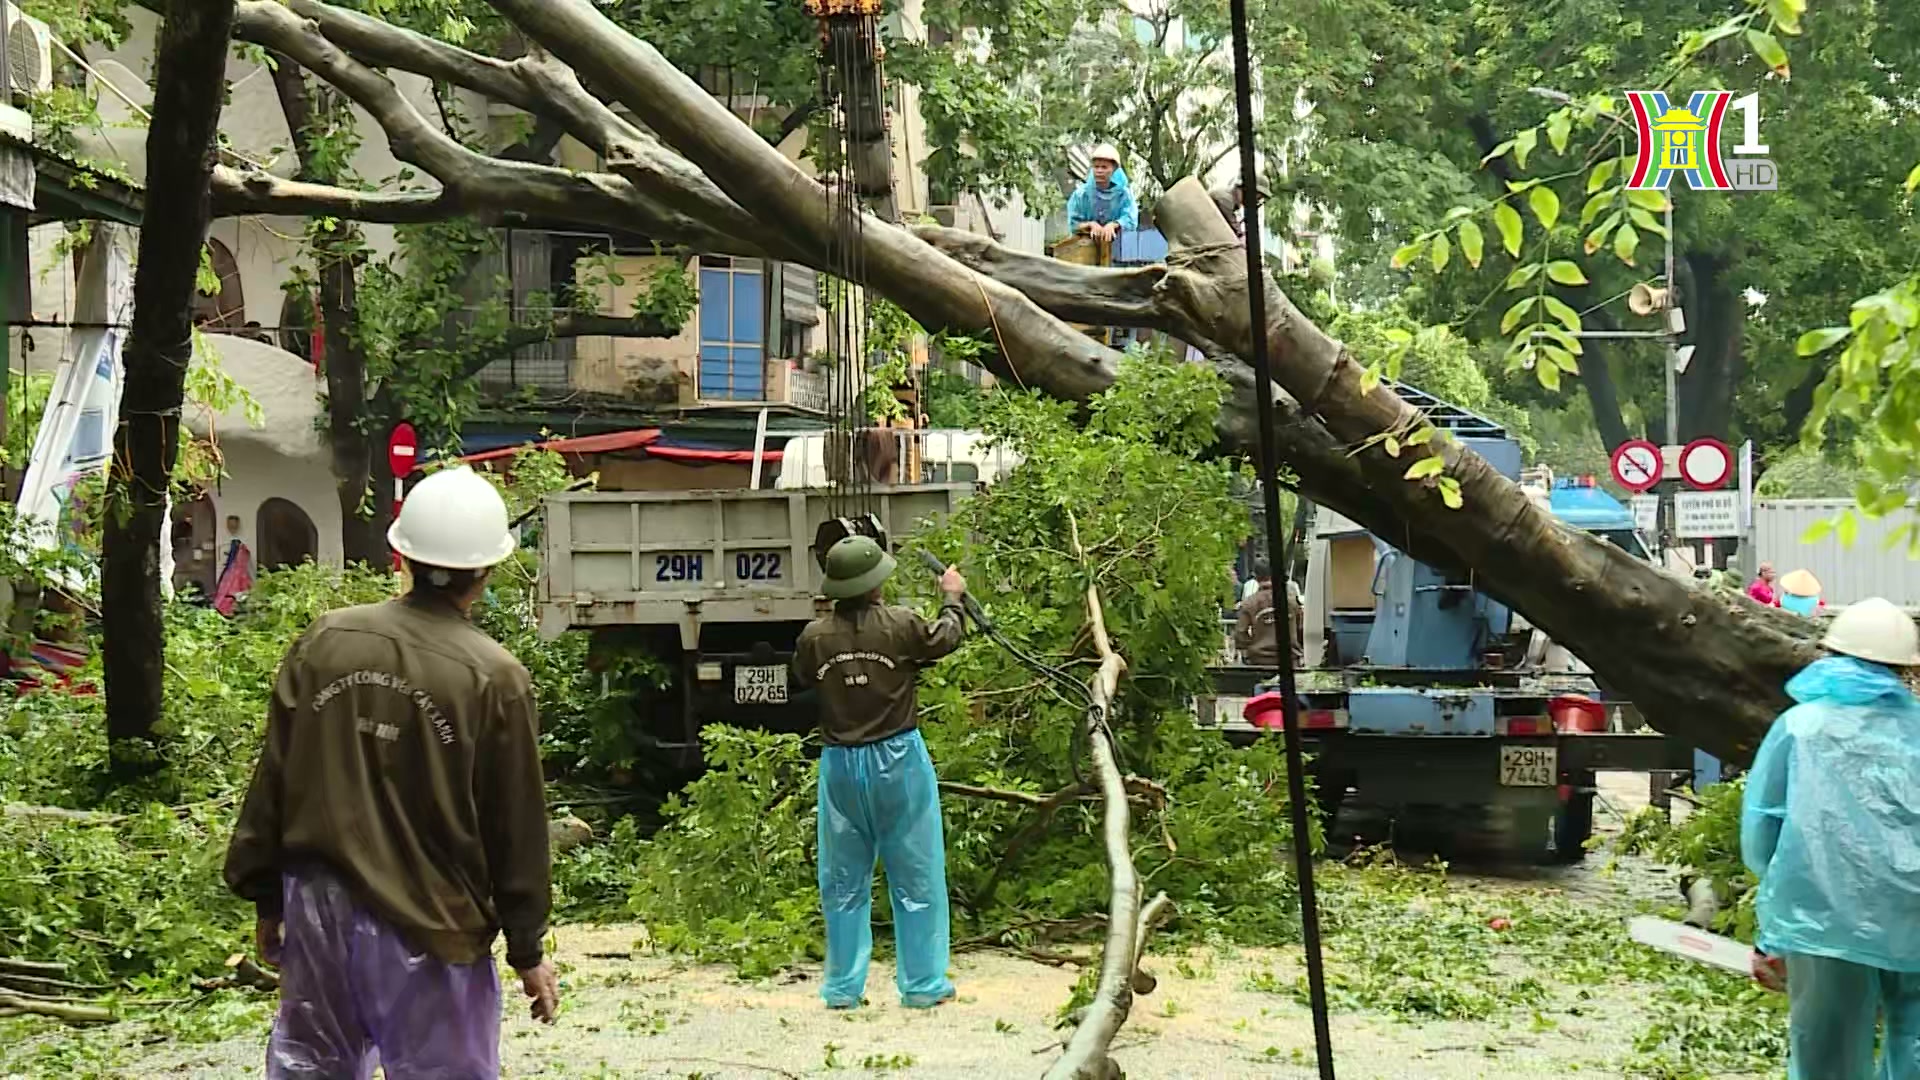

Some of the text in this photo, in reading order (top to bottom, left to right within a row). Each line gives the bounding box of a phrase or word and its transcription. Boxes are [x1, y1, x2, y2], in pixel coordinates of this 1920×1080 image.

[656, 555, 703, 581] 29H
[736, 553, 782, 581] 022
[748, 669, 775, 684] 29H
[1512, 750, 1545, 766] 29H
[1505, 767, 1550, 786] 7443
